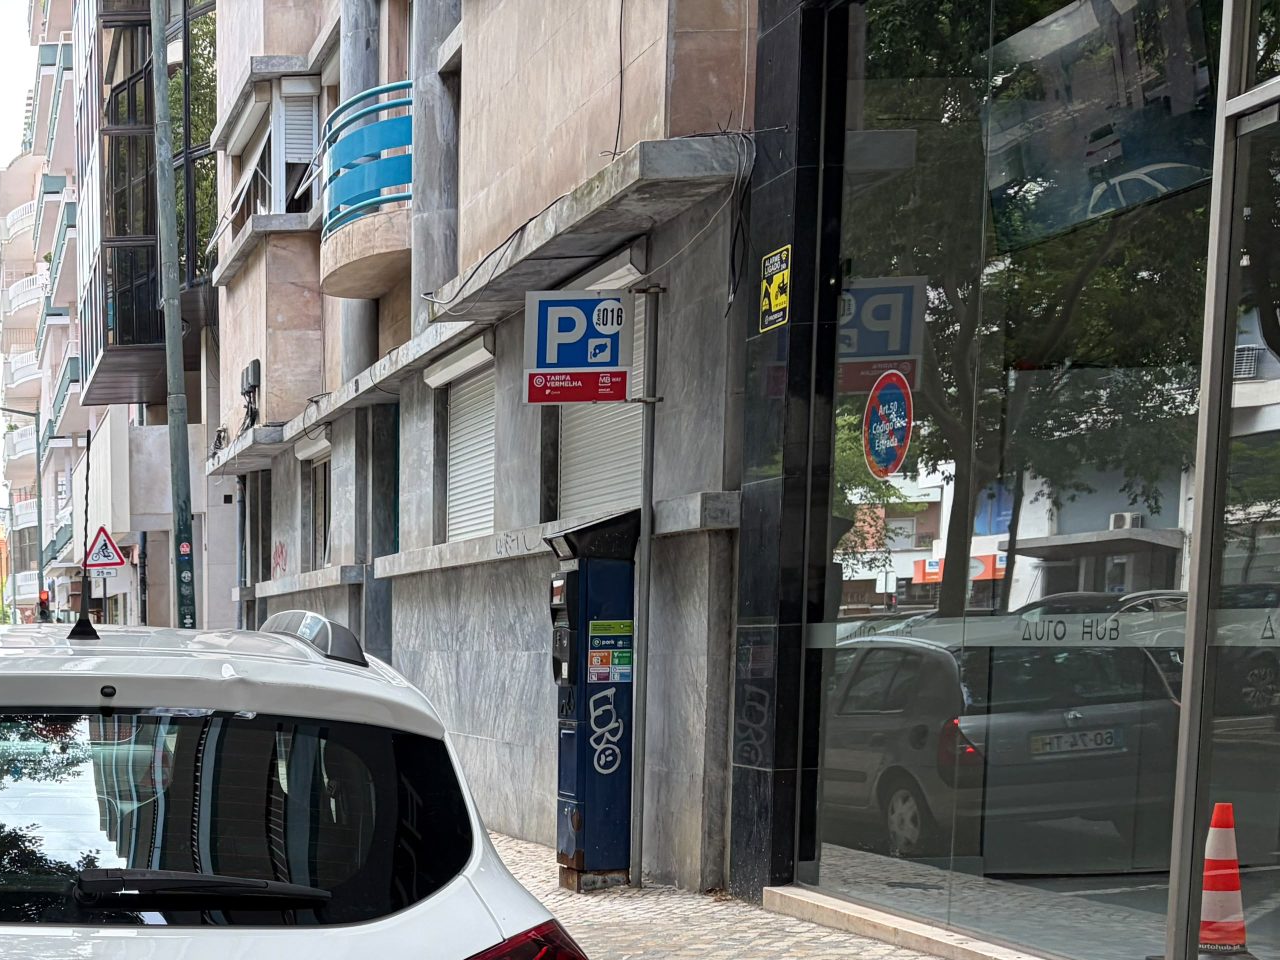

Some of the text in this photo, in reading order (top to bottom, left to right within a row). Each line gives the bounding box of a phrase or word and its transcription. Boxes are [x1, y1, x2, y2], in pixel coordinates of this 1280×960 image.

[765, 254, 781, 266] ALARME
[765, 261, 781, 275] LIGADO
[602, 308, 624, 326] 016
[546, 306, 588, 364] P
[873, 421, 894, 434] Código
[875, 434, 898, 451] Estrada
[1081, 618, 1120, 641] HUB
